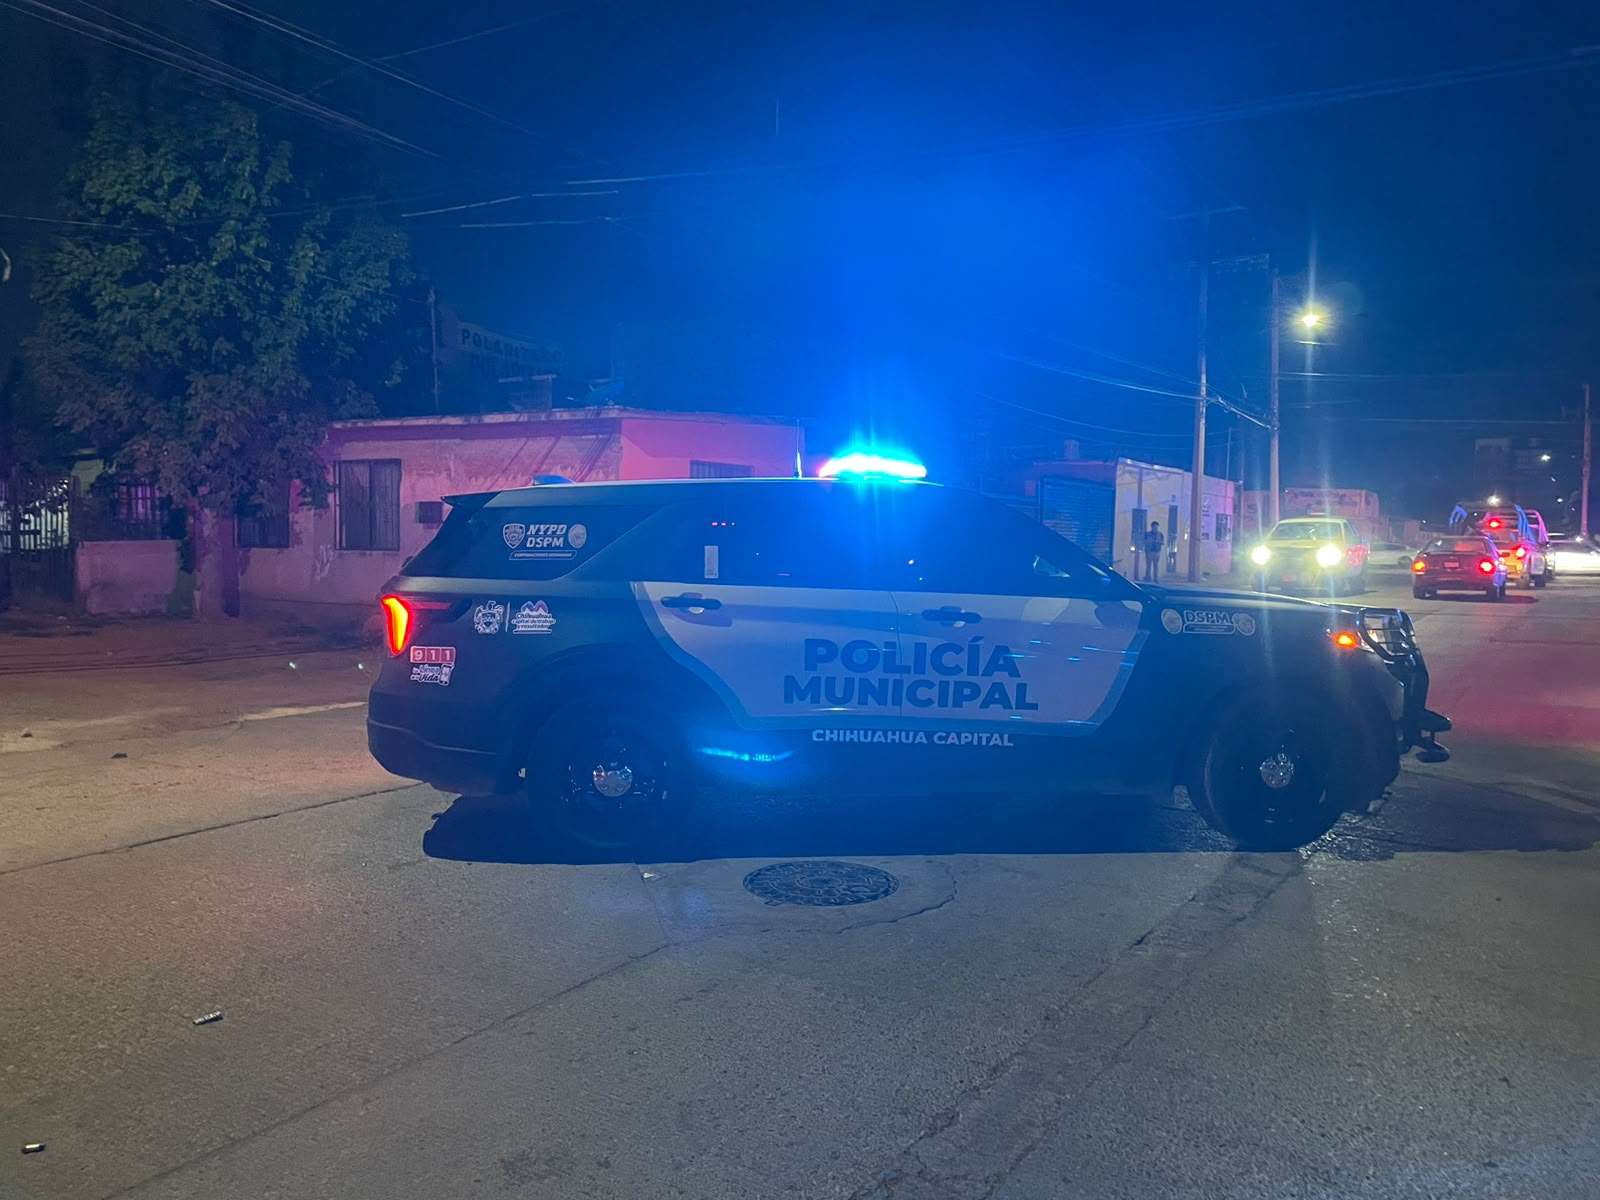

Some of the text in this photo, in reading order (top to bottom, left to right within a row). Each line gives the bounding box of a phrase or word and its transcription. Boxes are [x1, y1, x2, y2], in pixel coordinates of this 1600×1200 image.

[527, 524, 567, 535] NYPD
[526, 537, 564, 548] DSPM
[1183, 610, 1231, 624] DSPM
[414, 649, 451, 661] 911
[804, 636, 1021, 678] POLICÍA
[783, 675, 1039, 712] MUNICIPAL
[812, 729, 1014, 747] CHIHUAHUA CAPITAL
